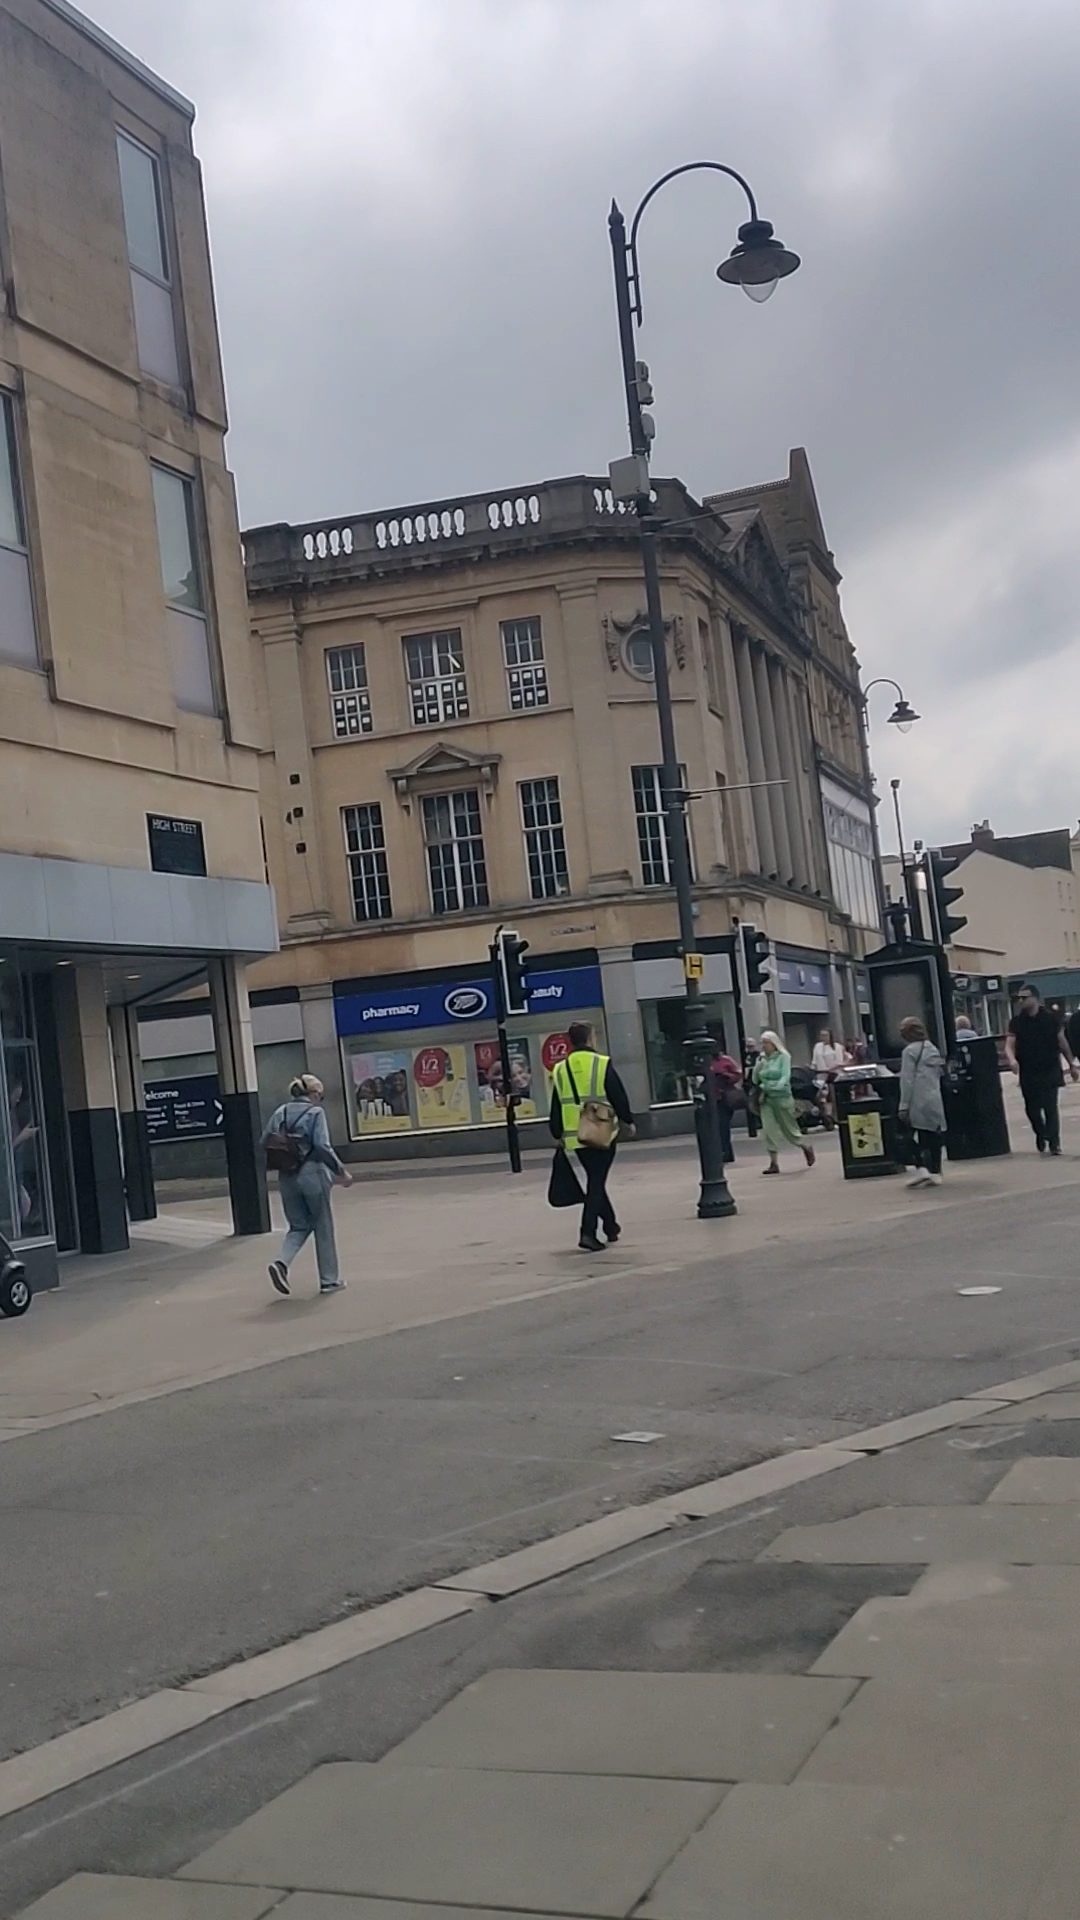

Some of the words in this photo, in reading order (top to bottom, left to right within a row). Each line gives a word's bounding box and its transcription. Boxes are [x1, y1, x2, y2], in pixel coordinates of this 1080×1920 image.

[152, 818, 171, 831] HIGH
[172, 821, 197, 835] STREET
[362, 1003, 420, 1020] pharmacy
